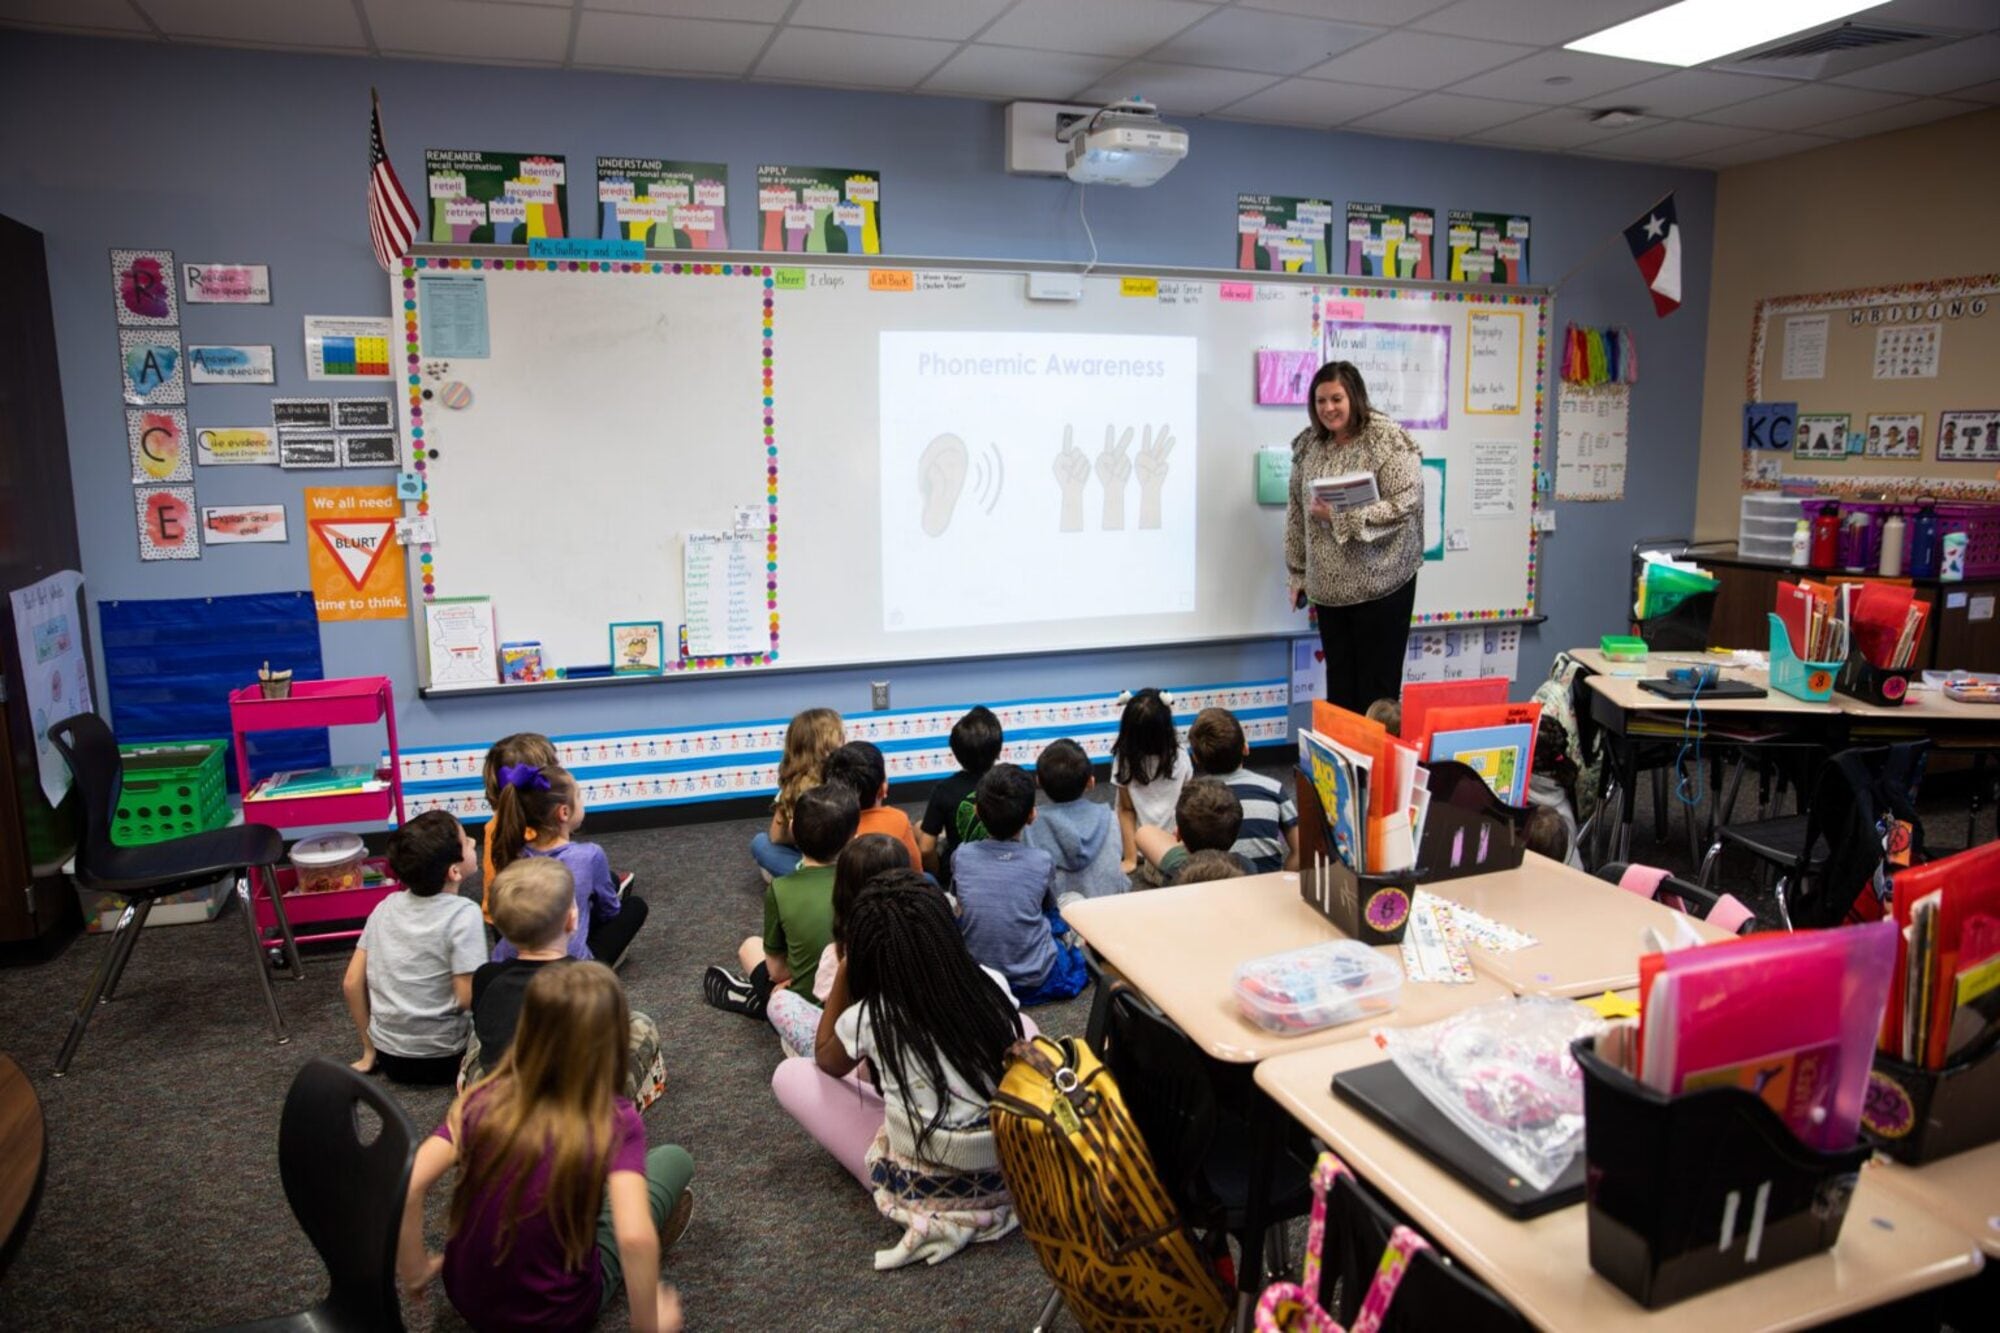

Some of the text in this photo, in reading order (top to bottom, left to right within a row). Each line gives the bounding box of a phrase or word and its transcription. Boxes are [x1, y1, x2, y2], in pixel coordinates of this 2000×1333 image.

[426, 151, 482, 161] REMEMBER
[428, 162, 502, 172] recall information
[598, 158, 662, 169] UNDERSTAND
[523, 167, 561, 178] identify
[599, 169, 694, 182] create personal meaning
[758, 166, 787, 176] APPLY
[434, 182, 462, 191] retell
[781, 177, 818, 185] procedure
[506, 187, 553, 199] recognize
[600, 187, 633, 198] predict
[649, 189, 688, 200] compare
[1239, 195, 1271, 205] ANALYZE
[490, 206, 525, 216] restate
[618, 207, 667, 217] summarize
[1347, 203, 1382, 213] EVALUATE
[674, 213, 715, 224] conclude
[1449, 211, 1473, 221] CREATE
[593, 243, 609, 256] and
[133, 270, 154, 305] R
[202, 286, 266, 297] the question
[1852, 302, 1985, 323] WRITING
[1329, 329, 1348, 349] We
[1350, 331, 1367, 349] will
[193, 348, 239, 369] Answer
[140, 349, 163, 383] A
[918, 352, 1165, 378] Phonemic Awareness
[206, 366, 271, 378] the question
[1747, 417, 1791, 450] KC
[141, 426, 172, 462] C
[228, 438, 273, 447] evidence
[313, 497, 393, 509] We all need
[158, 505, 179, 539] E
[250, 513, 268, 521] and
[335, 537, 377, 548] BLURT
[316, 596, 407, 611] time to think.
[1407, 669, 1426, 682] four
[1444, 663, 1463, 679] five
[1482, 664, 1495, 677] six
[1294, 682, 1314, 694] one
[421, 765, 428, 775] 2
[452, 763, 459, 772] 4
[581, 752, 590, 761] 12
[709, 740, 721, 751] 20
